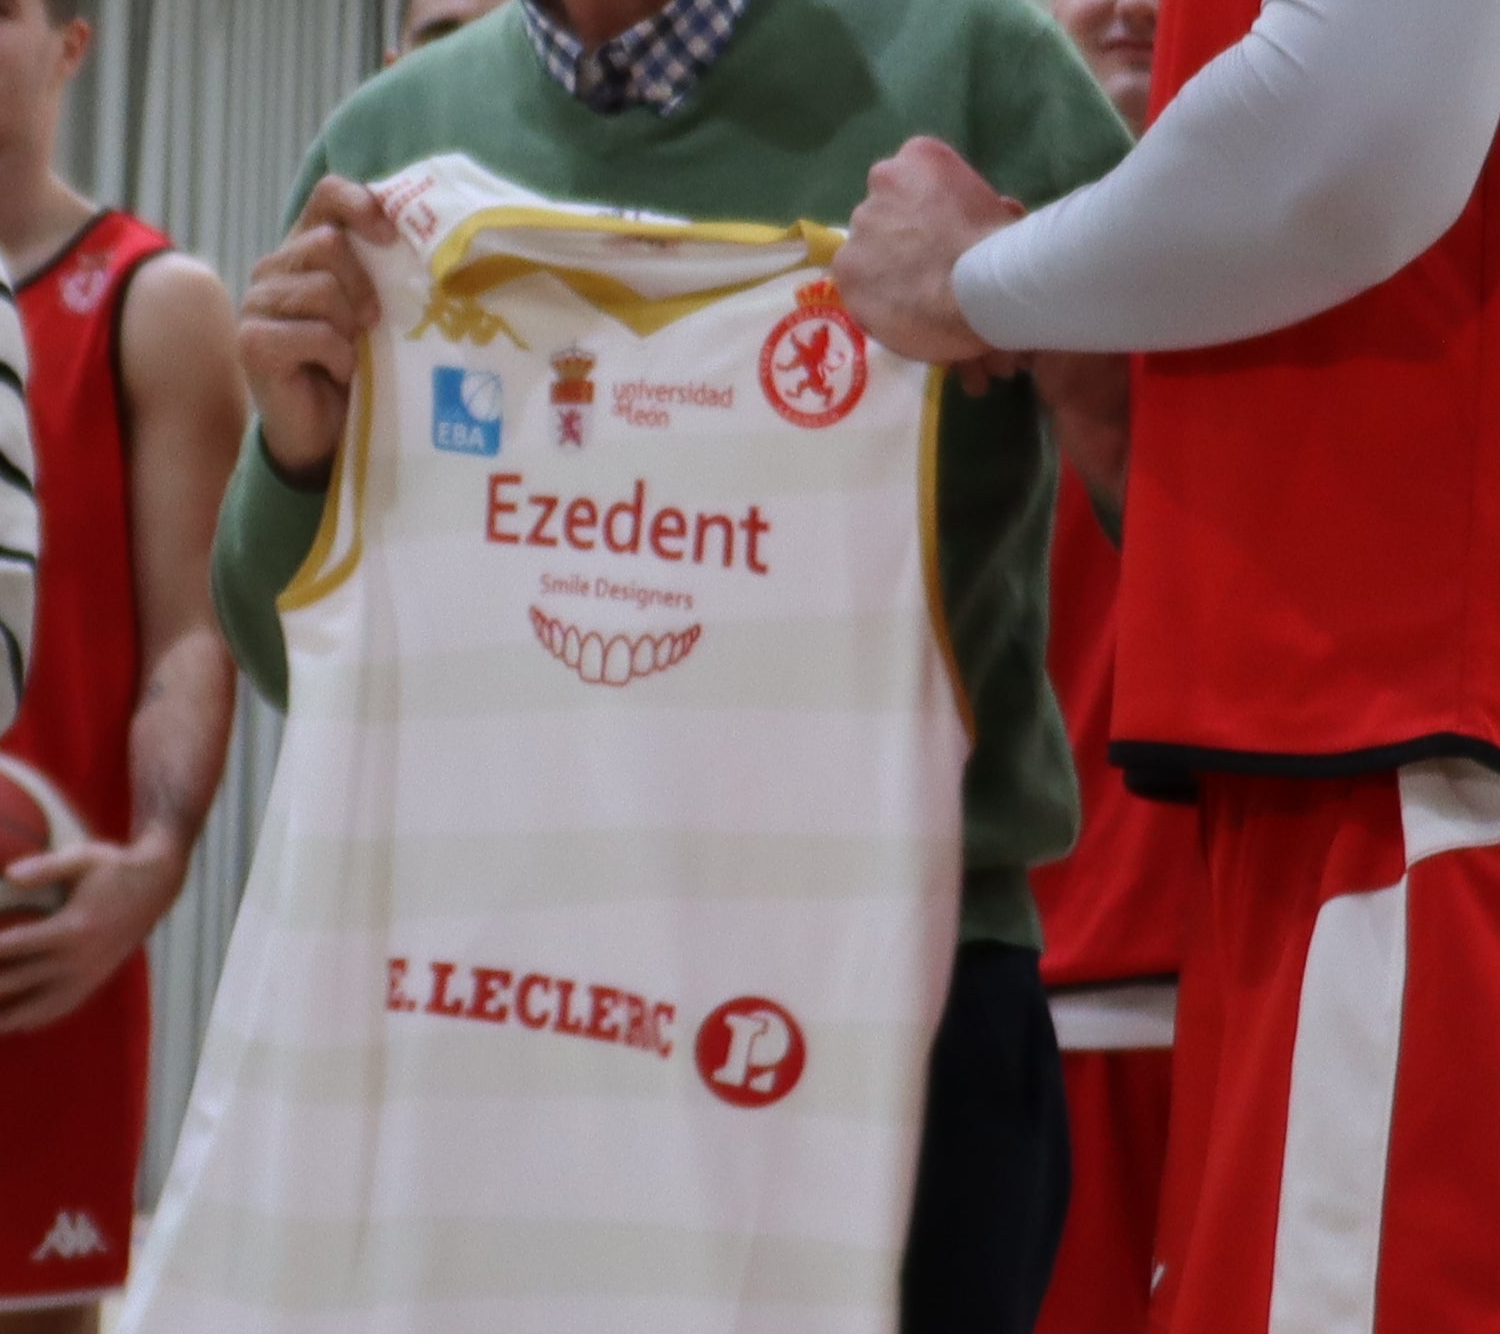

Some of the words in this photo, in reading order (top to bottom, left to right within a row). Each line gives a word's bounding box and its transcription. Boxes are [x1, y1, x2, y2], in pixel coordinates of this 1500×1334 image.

[612, 379, 734, 408] universidad
[437, 420, 484, 447] EBA
[486, 472, 770, 575] Ezedent
[540, 573, 590, 595] Smile
[595, 577, 694, 609] Designers
